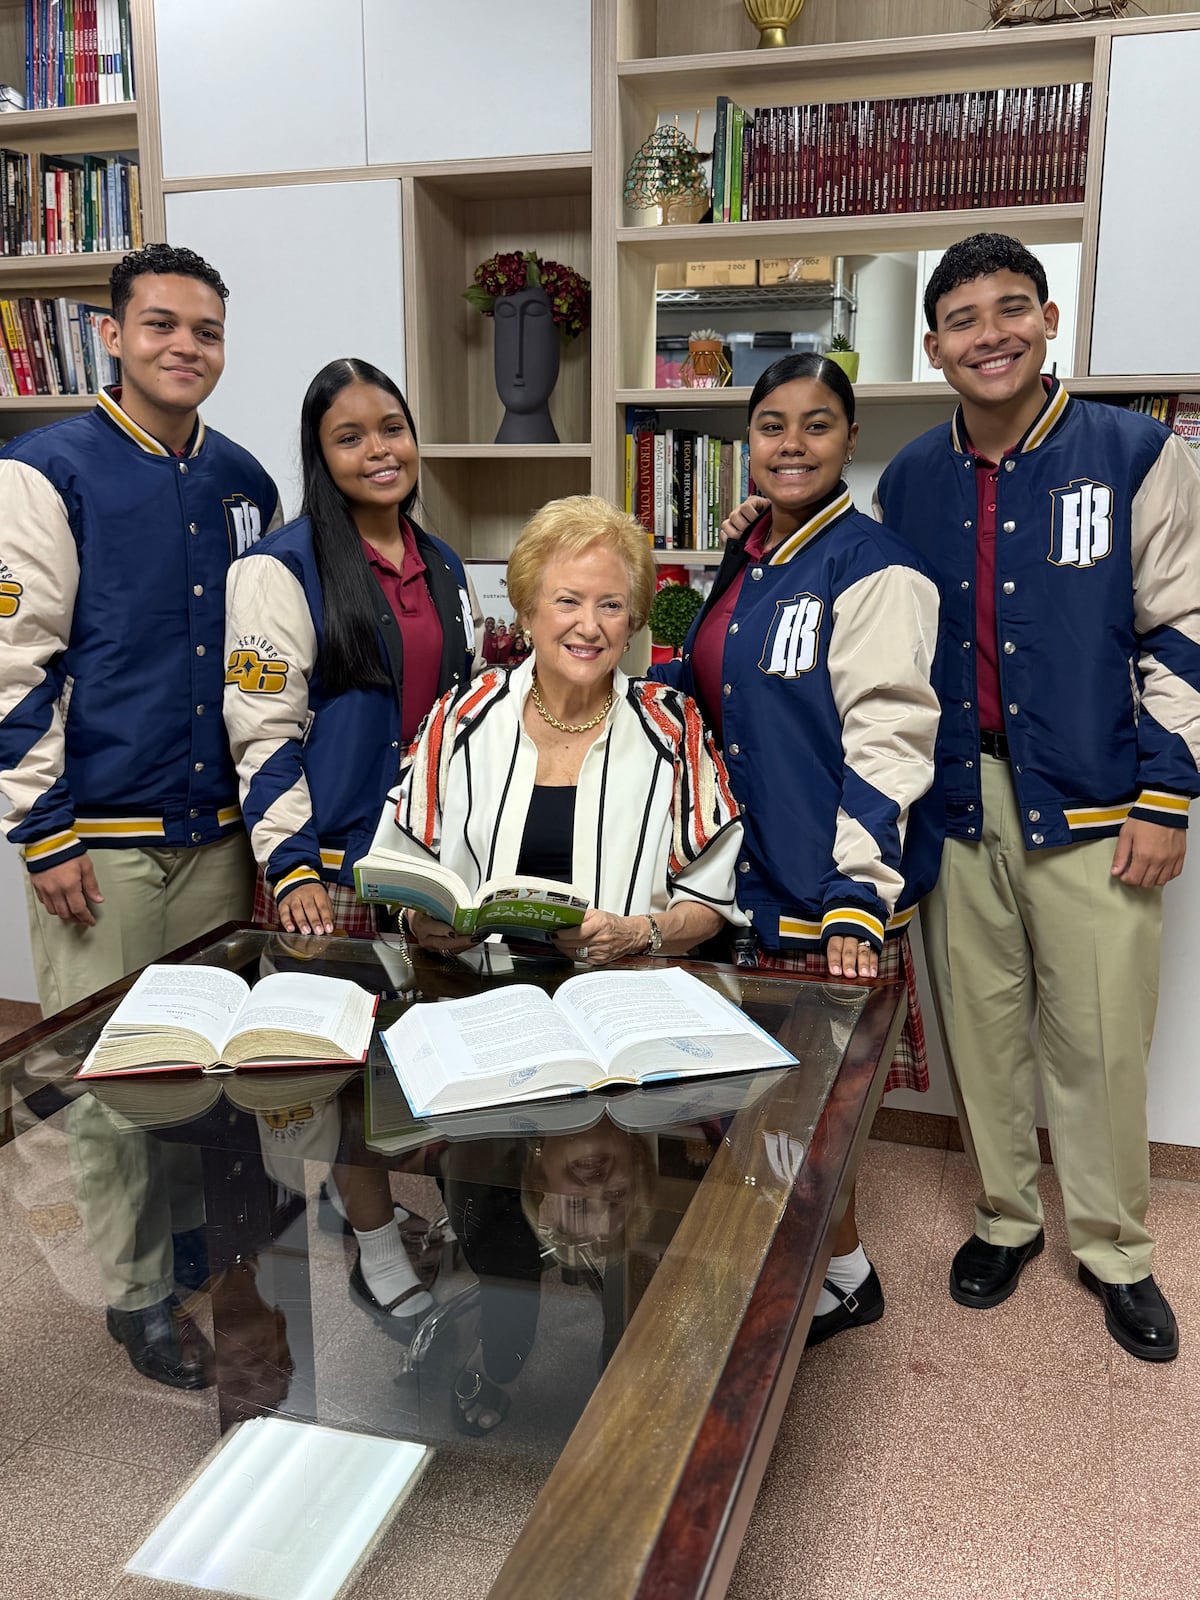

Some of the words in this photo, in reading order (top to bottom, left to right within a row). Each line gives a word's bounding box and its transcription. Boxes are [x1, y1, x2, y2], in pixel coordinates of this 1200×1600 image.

[640, 437, 651, 484] VERDAD
[655, 440, 664, 462] AMA
[656, 463, 663, 473] TU
[656, 475, 664, 508] CUERPO
[239, 634, 278, 658] SENIORS
[224, 649, 289, 694] 26
[486, 911, 568, 924] DANIEL
[497, 905, 555, 915] PLAN
